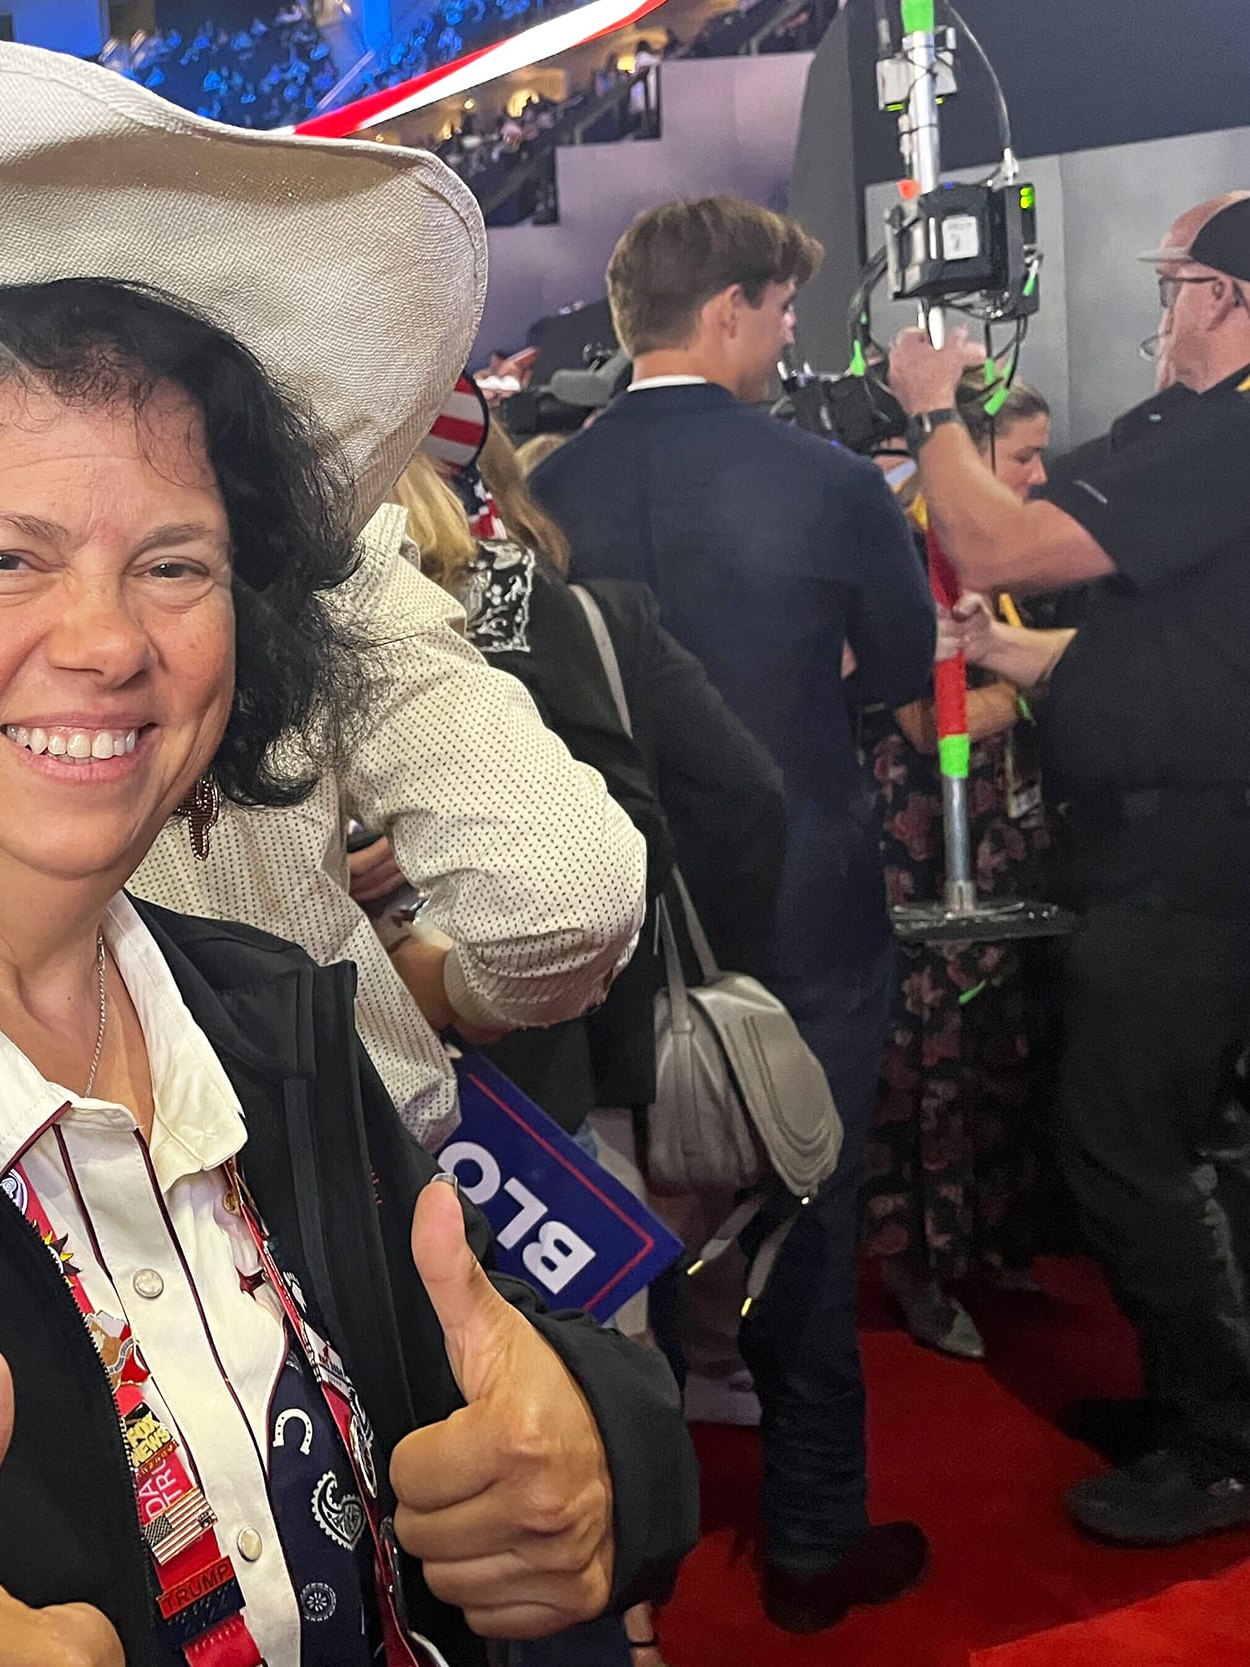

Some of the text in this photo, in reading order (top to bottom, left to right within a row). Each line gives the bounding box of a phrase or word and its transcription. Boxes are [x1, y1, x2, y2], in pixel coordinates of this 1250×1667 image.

[126, 1412, 161, 1448] FOX
[131, 1427, 171, 1467] NEWS
[165, 1562, 229, 1611] TRUMP
